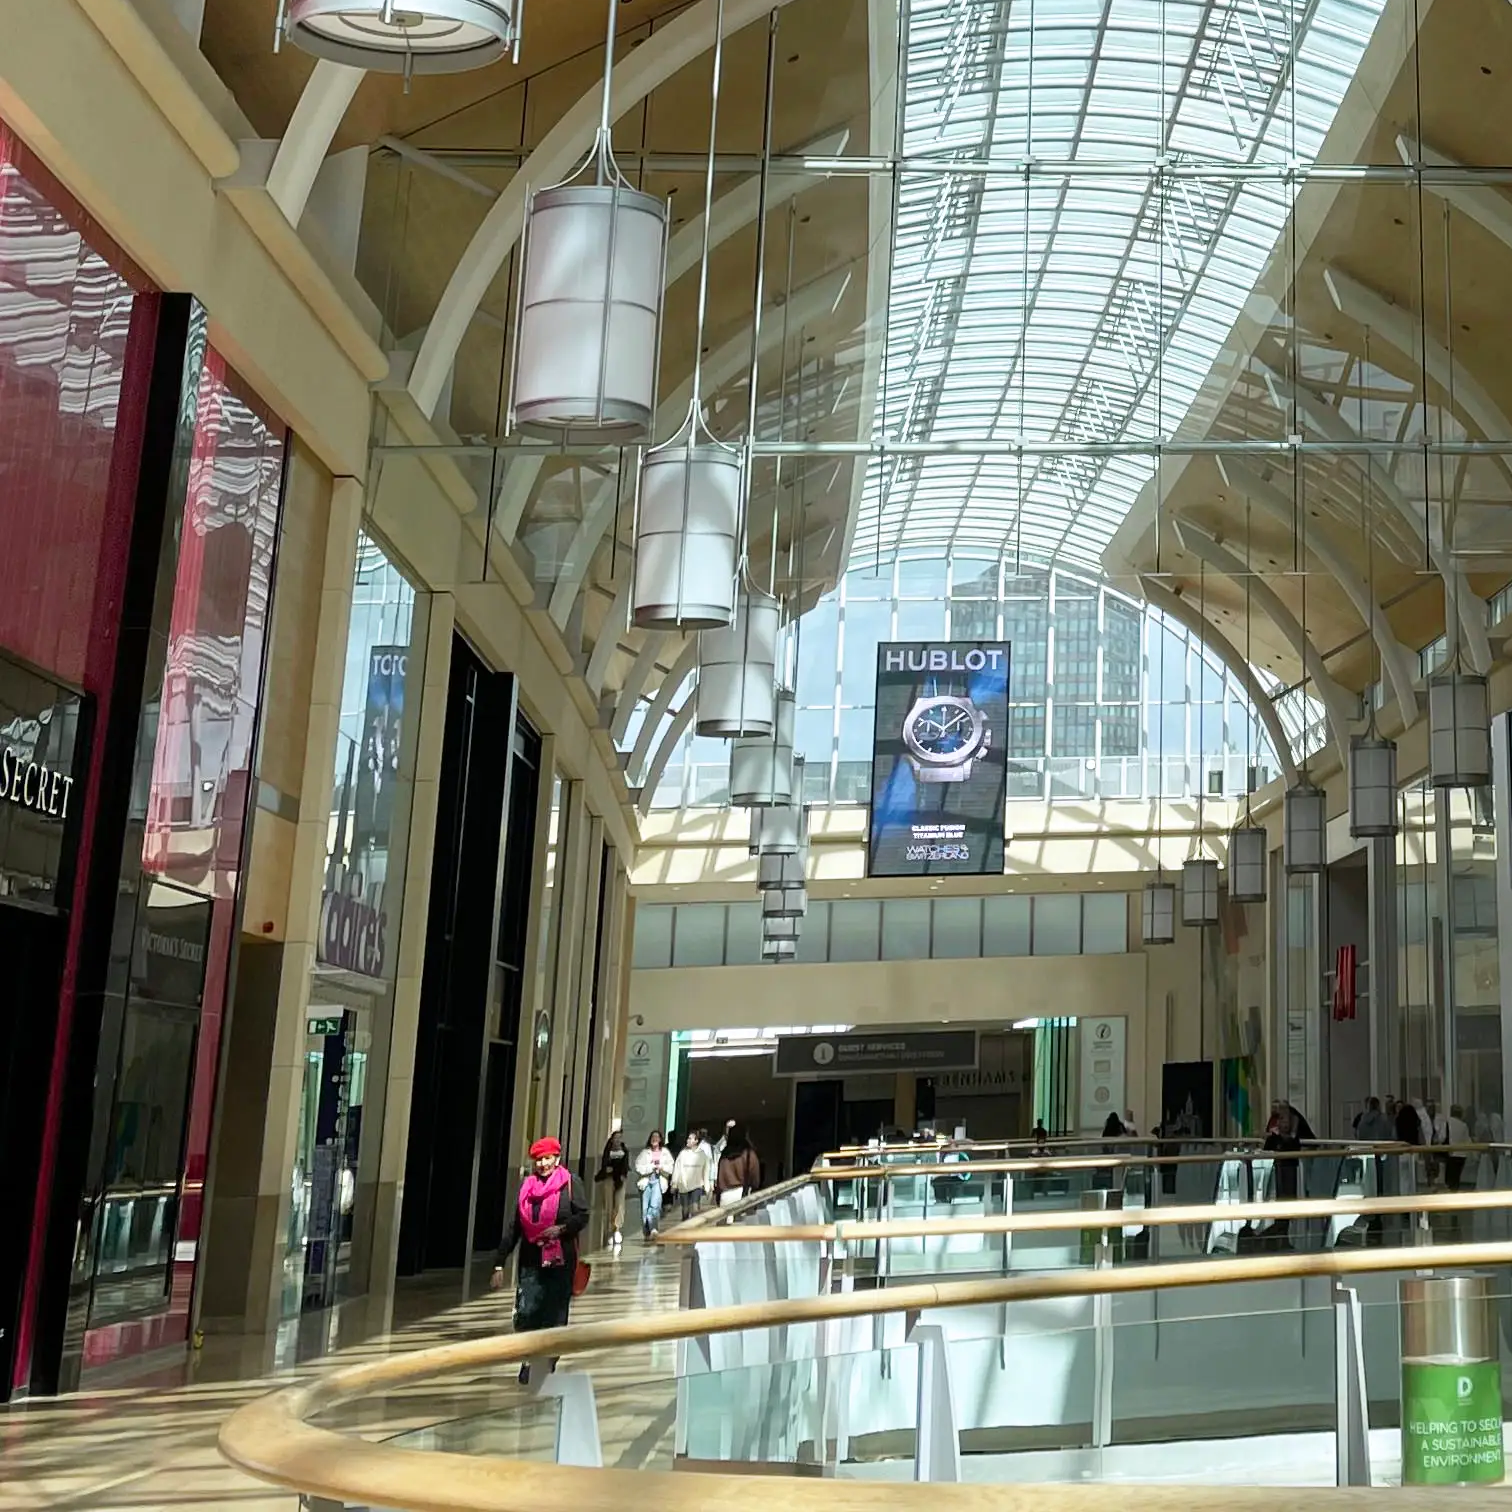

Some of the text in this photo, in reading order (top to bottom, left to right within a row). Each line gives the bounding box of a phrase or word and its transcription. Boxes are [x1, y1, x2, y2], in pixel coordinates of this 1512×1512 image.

[886, 649, 1002, 671] HUBLOT
[0, 746, 73, 819] SECRET
[1457, 1376, 1473, 1397] D
[1410, 1420, 1458, 1435] HELPING
[1460, 1420, 1477, 1433] TO
[1421, 1439, 1429, 1451] A
